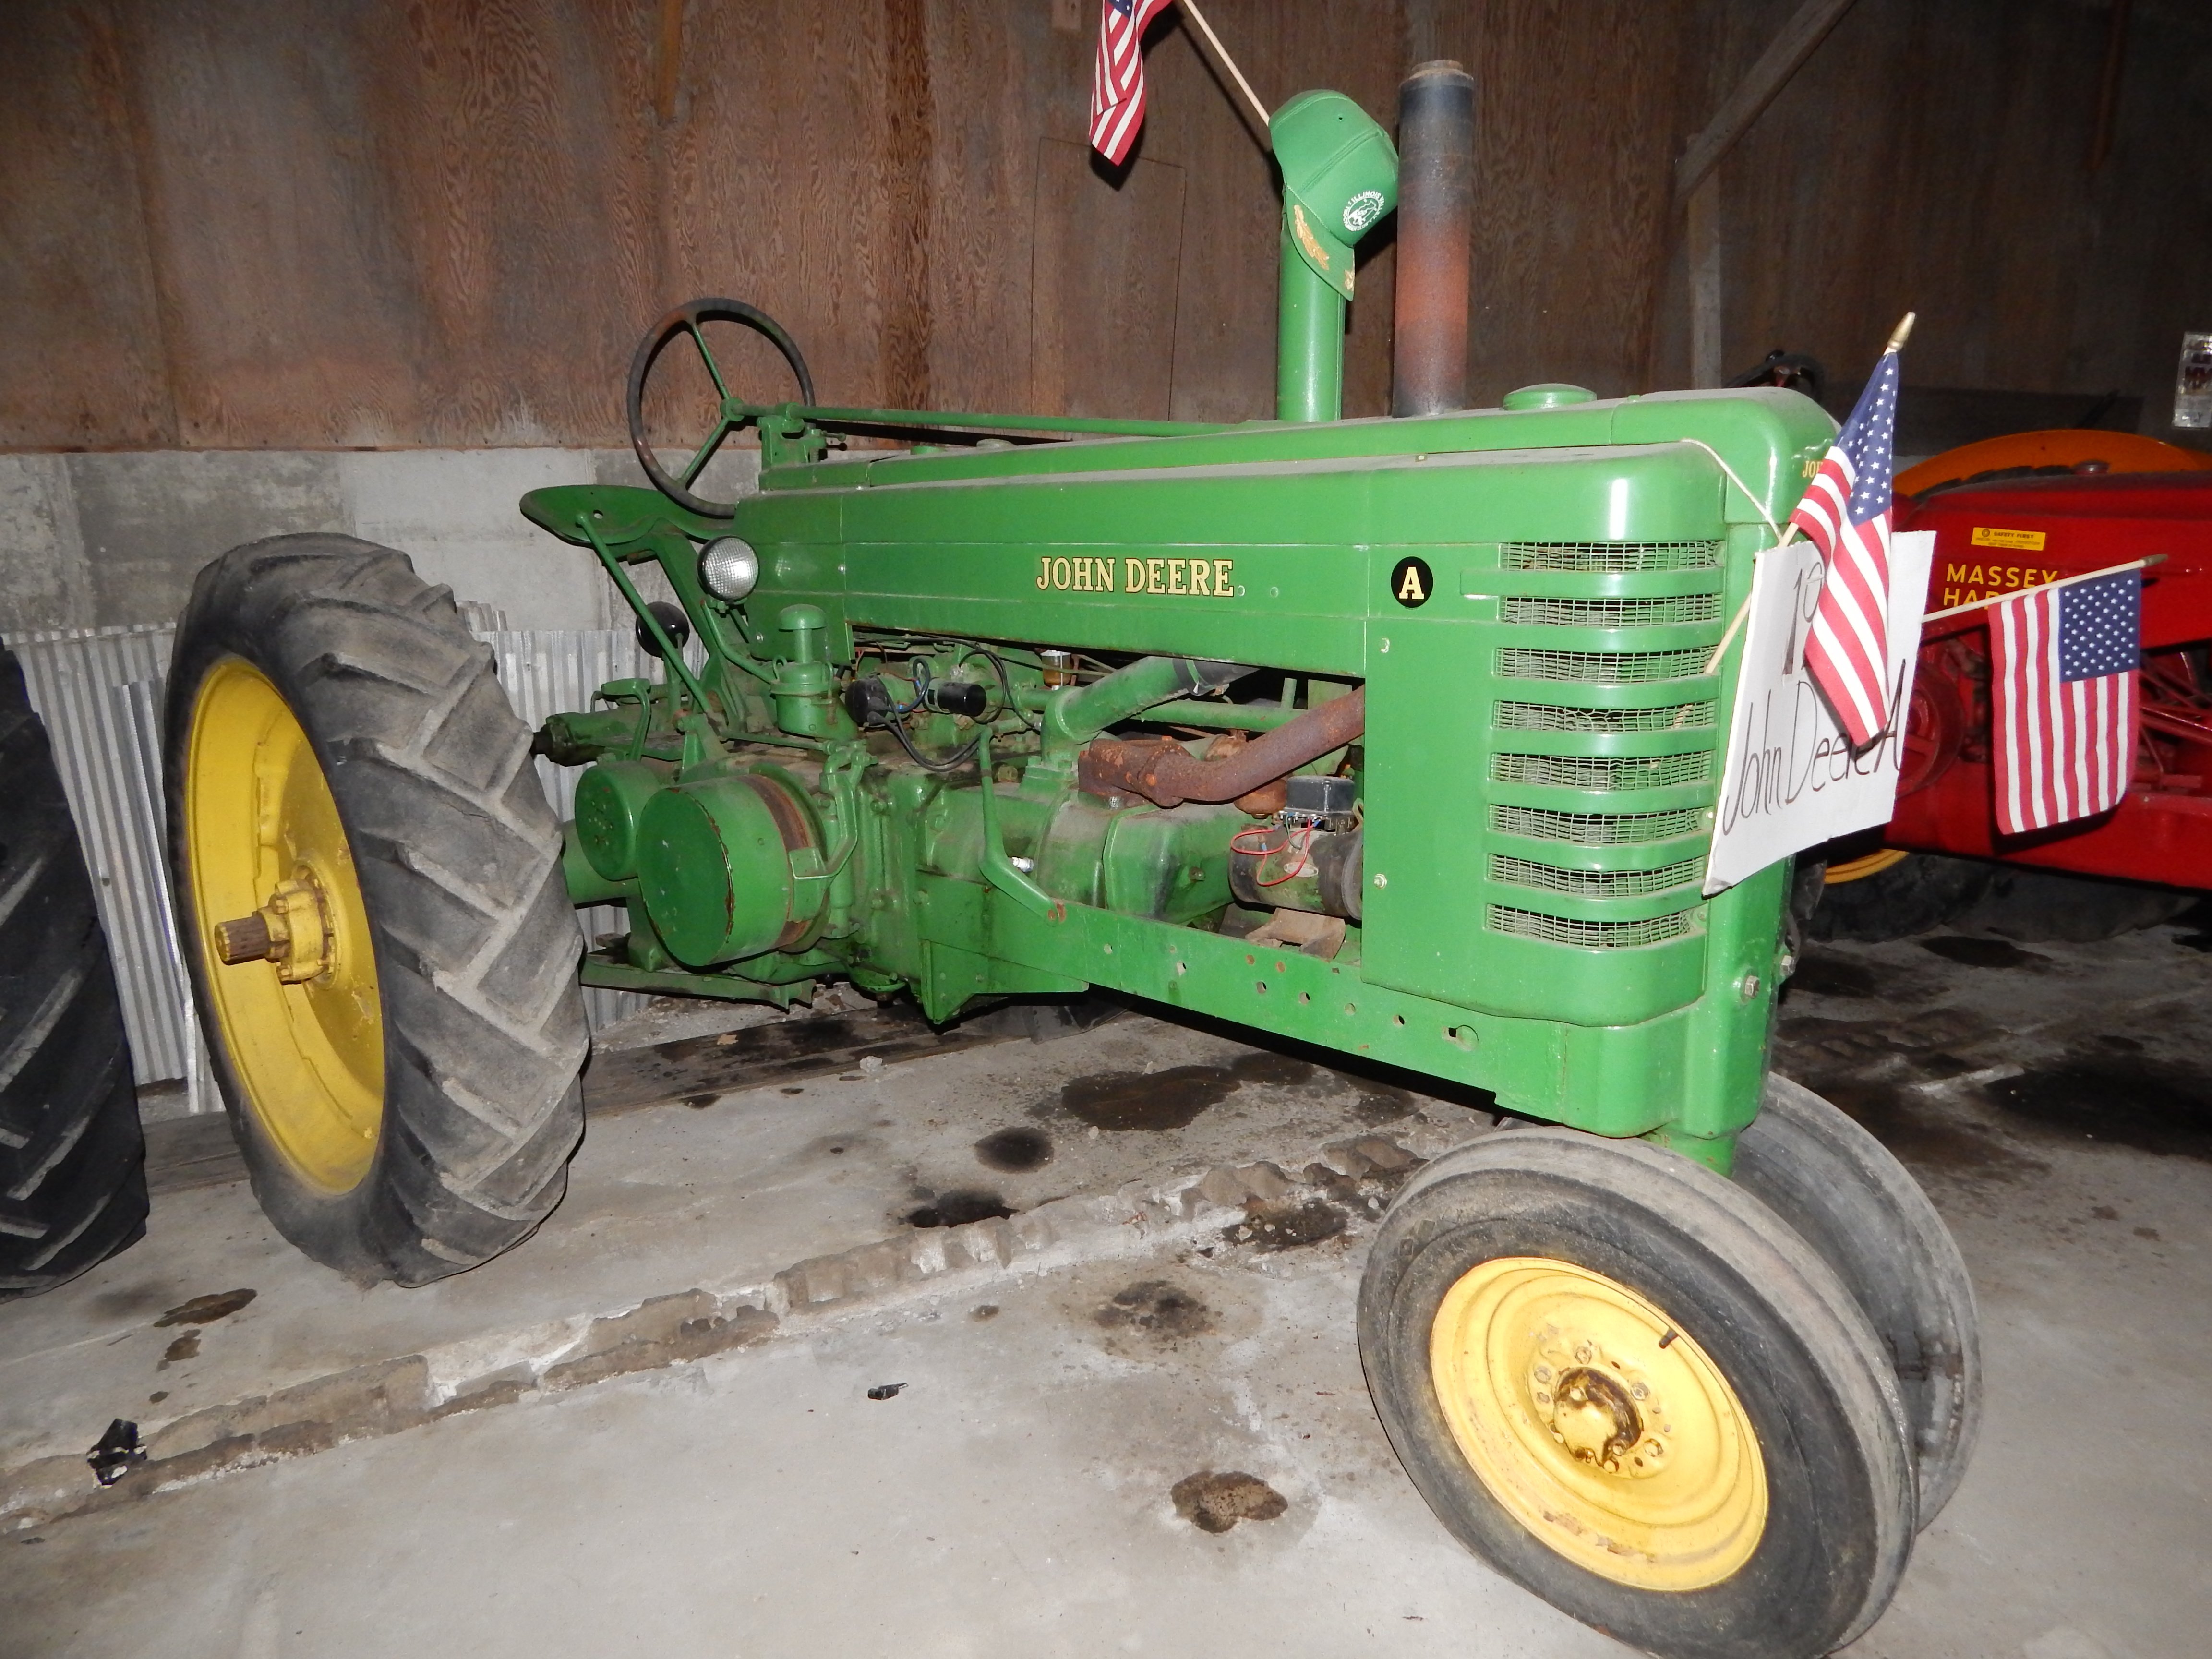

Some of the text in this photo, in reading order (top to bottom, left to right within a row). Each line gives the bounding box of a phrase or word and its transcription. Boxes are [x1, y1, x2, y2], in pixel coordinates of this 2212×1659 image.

[1351, 190, 1381, 203] ILLINOIS
[1036, 556, 1234, 597] JOHN DEERE
[1399, 566, 1424, 600] A
[1946, 563, 2058, 588] MASSEY
[1782, 562, 1824, 674] 19
[1722, 689, 1783, 836] John
[1873, 658, 1906, 773] A
